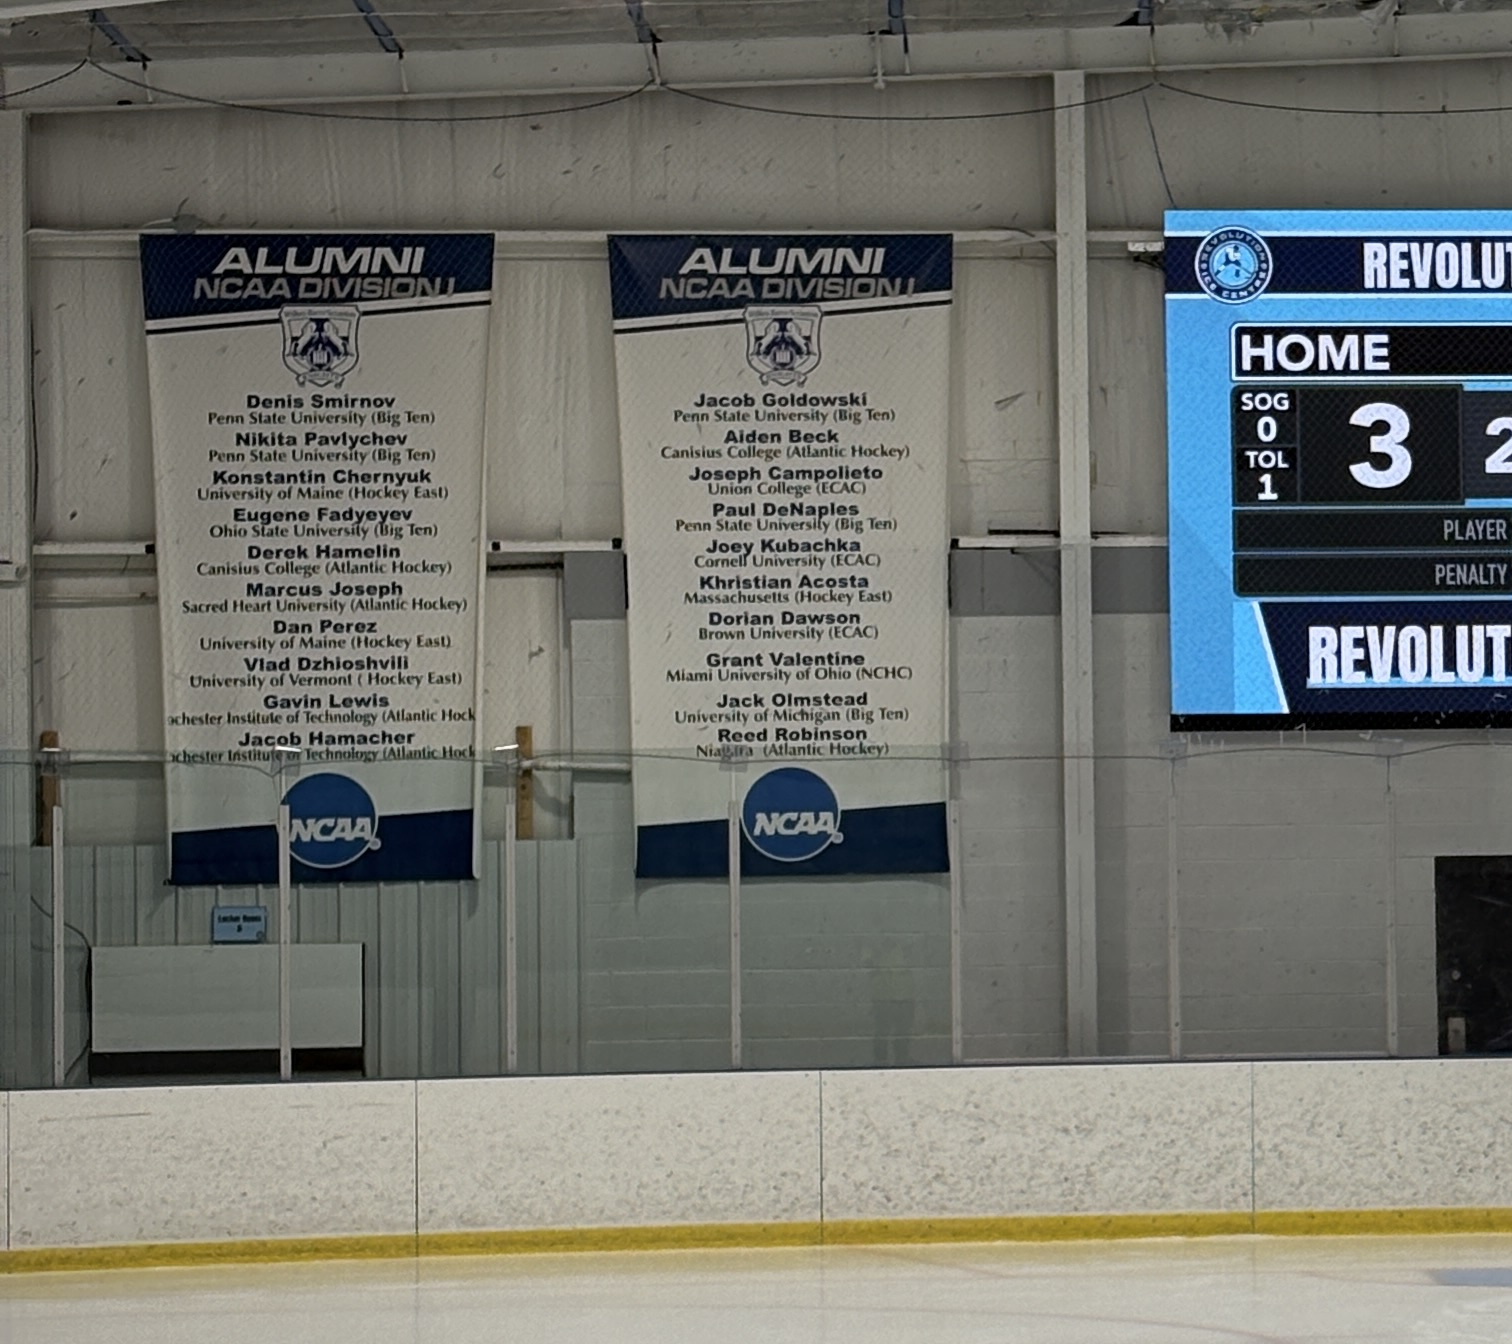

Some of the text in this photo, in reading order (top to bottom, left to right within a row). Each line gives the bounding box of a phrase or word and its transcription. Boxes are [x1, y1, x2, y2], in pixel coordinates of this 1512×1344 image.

[212, 246, 425, 274] ALUMNI
[679, 247, 886, 275] ALUMNI
[193, 277, 290, 300] NCAA
[298, 277, 443, 299] DIVISION
[659, 278, 755, 299] NCAA
[761, 277, 901, 299] DIVISION
[1240, 333, 1391, 372] HOME
[247, 393, 395, 409] Denis Smirnov
[694, 391, 867, 407] Jacob Goldowski
[1241, 393, 1290, 411] SOG
[208, 412, 435, 427] Penn State University (Big Ten)
[724, 428, 839, 444] Aiden Beck
[1257, 416, 1277, 442] 0
[236, 431, 407, 450] Nikita Pavlychev
[1348, 402, 1412, 488] 3
[1244, 451, 1289, 469] TOL
[213, 468, 431, 488] Konstantin Chernyuk
[689, 464, 883, 485] Joseph Campolieto
[708, 482, 866, 498] Union College (ECAC)
[1257, 474, 1278, 500] 1
[233, 506, 412, 526] Eugene Fadyeyev
[713, 500, 859, 520] Paul DeNaples
[1443, 519, 1507, 541] PLAYER
[248, 543, 400, 559] Derek Hamelin
[706, 537, 861, 558] Joey Kubachka
[700, 573, 869, 590] Khristian Acosta
[1435, 564, 1507, 585] PENALTY
[246, 581, 403, 600] Marcus Joseph
[182, 599, 467, 615] Sacred Heart University (Atlantic Hockey)
[273, 618, 377, 634] Dan Perez
[709, 609, 860, 625] Dorian Dawson
[699, 626, 878, 643] Brown University (ECAC)
[244, 656, 290, 672] Vlad
[707, 651, 865, 667] Grant Valentine
[264, 692, 389, 709] Gavin Lewis
[717, 691, 868, 708] Jack Olmstead
[239, 729, 415, 746] Jacob Hamacher
[718, 726, 867, 742] Reed Robinson
[290, 817, 372, 842] NCAA
[754, 811, 835, 837] NCAA
